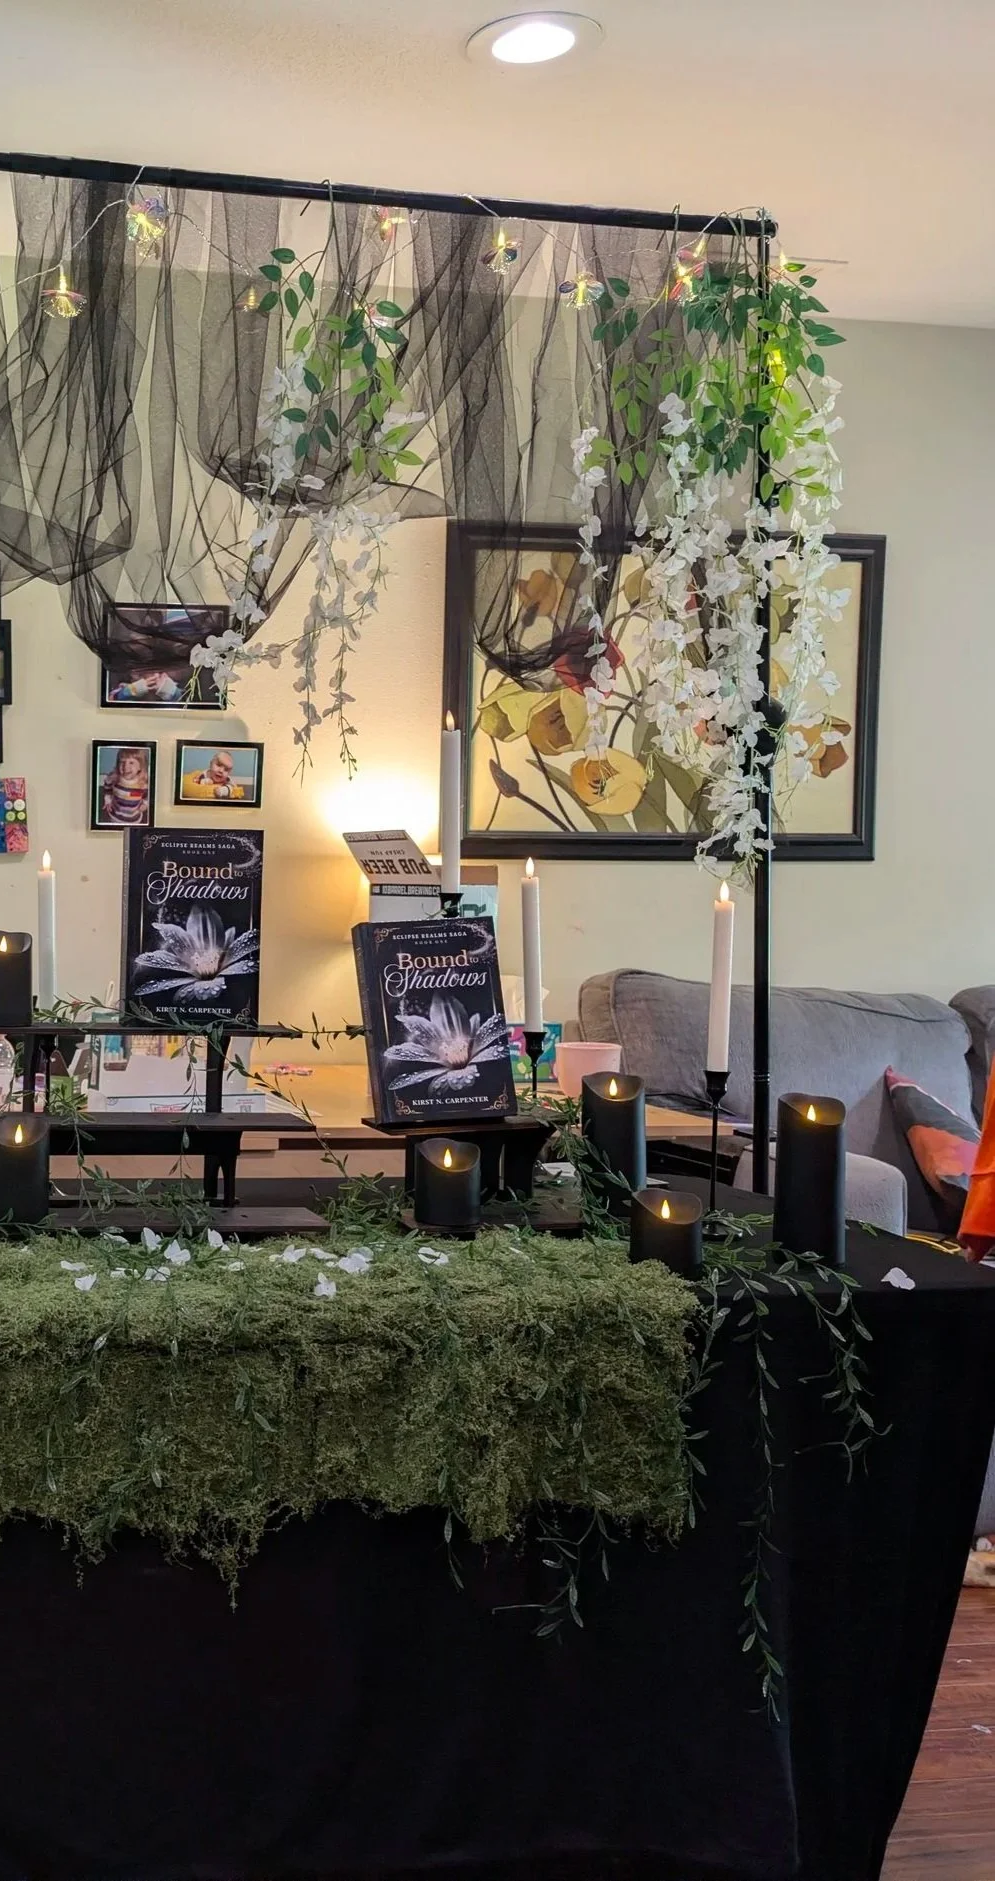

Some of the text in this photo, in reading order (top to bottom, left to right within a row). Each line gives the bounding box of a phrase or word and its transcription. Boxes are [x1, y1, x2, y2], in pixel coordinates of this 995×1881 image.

[162, 860, 234, 880] Bound
[360, 858, 432, 875] PUB BEER
[146, 871, 250, 905] Shadows
[396, 949, 470, 970] Bound
[384, 964, 487, 998] Shadows
